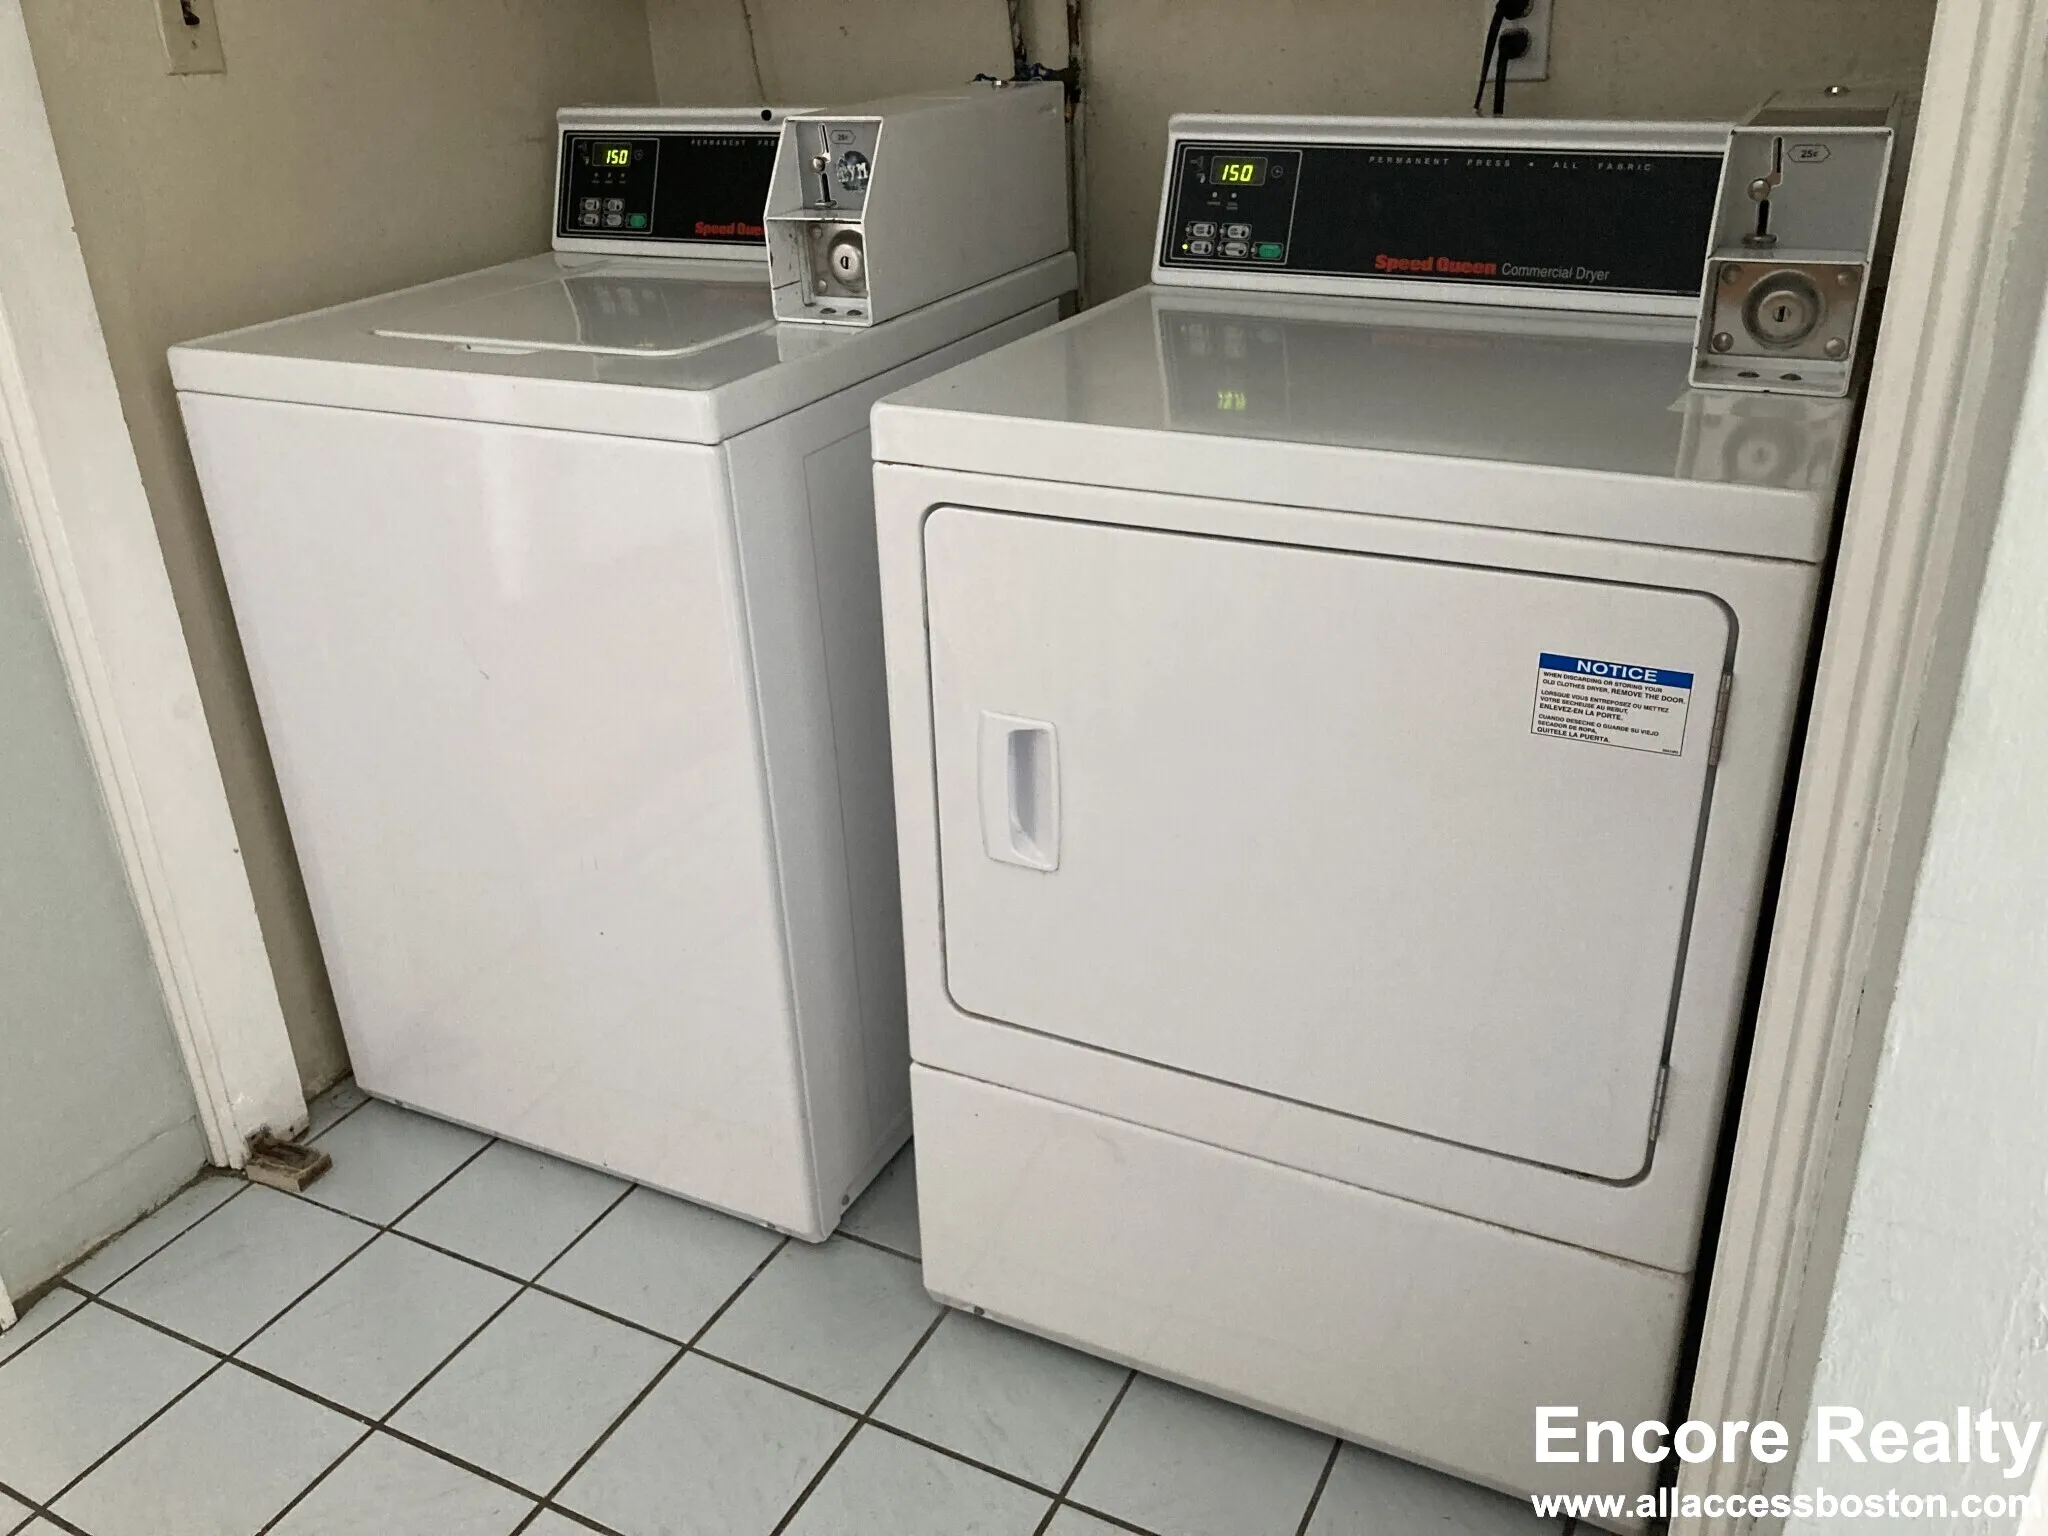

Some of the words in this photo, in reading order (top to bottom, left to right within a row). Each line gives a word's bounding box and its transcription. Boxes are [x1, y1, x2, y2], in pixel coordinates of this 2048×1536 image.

[606, 150, 629, 164] 150
[1800, 149, 1819, 158] 25¢
[1222, 164, 1254, 182] 150
[1368, 156, 1450, 166] PERMANENT
[1466, 158, 1511, 168] PRESS
[1552, 161, 1579, 169] ALL
[1598, 163, 1652, 172] FABRIC
[695, 221, 735, 237] Speed
[1375, 254, 1433, 272] Speed
[1436, 257, 1497, 275] Queen
[1501, 262, 1573, 279] Commercial
[1576, 266, 1610, 283] Dryer
[1577, 660, 1658, 682] NOTICE
[1543, 671, 1562, 679] WHEN
[1563, 674, 1602, 684] DISCARDING
[1614, 681, 1643, 690] STORING
[1540, 695, 1561, 704] VOTRE
[1540, 689, 1571, 698] LORSQUE
[1571, 693, 1589, 701] VOUS
[1590, 696, 1632, 708] ENTREPOSEZ
[1643, 704, 1670, 713] METTEZ
[1556, 680, 1586, 690] CLOTHES
[1611, 688, 1643, 698] REMOVE
[1644, 692, 1660, 701] THE
[1661, 695, 1686, 704] DOOR.
[1539, 702, 1584, 714] ENLEVEZ-EN
[1596, 711, 1623, 720] PORTE.
[1537, 719, 1568, 729] SECADOR
[1538, 713, 1565, 722] CUANDO
[1565, 717, 1596, 727] DESECHE
[1602, 723, 1629, 733] GUARDE
[1640, 729, 1660, 737] VIEJO
[1537, 726, 1568, 737] QUITELE
[1579, 733, 1611, 743] PUERTA.
